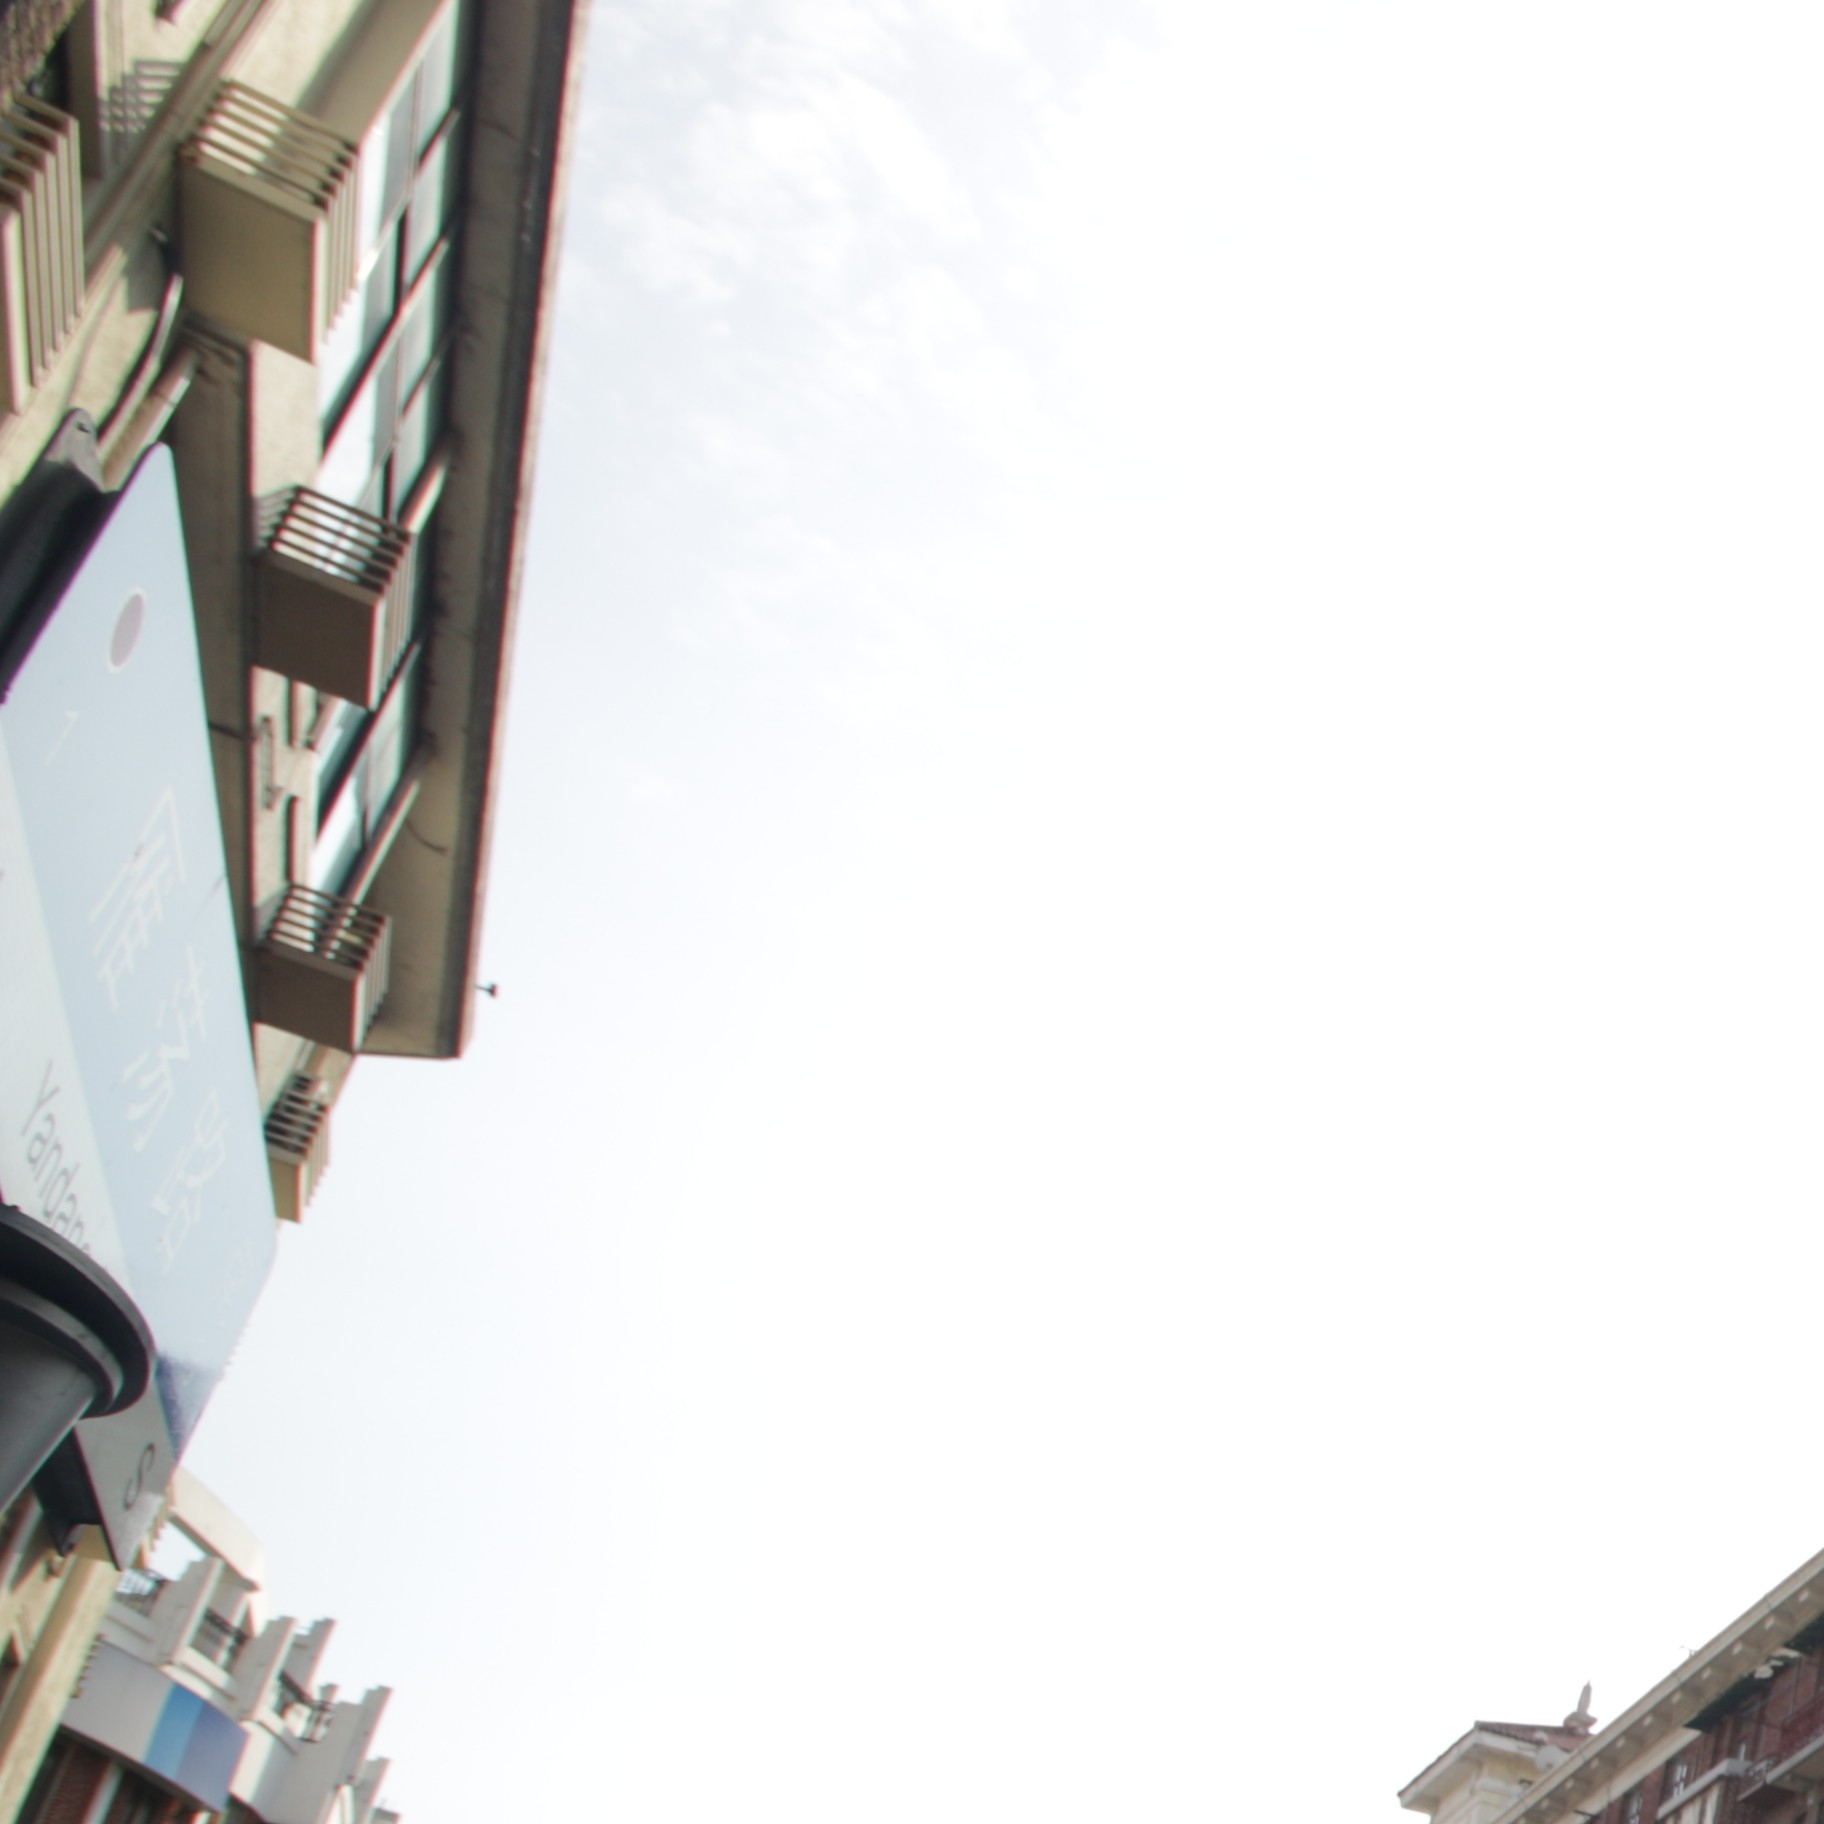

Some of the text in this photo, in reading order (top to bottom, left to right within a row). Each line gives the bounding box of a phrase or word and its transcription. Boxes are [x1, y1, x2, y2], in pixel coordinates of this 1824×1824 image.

[20, 1056, 91, 1256] Yandan
[88, 784, 231, 1277] 雁荡路
